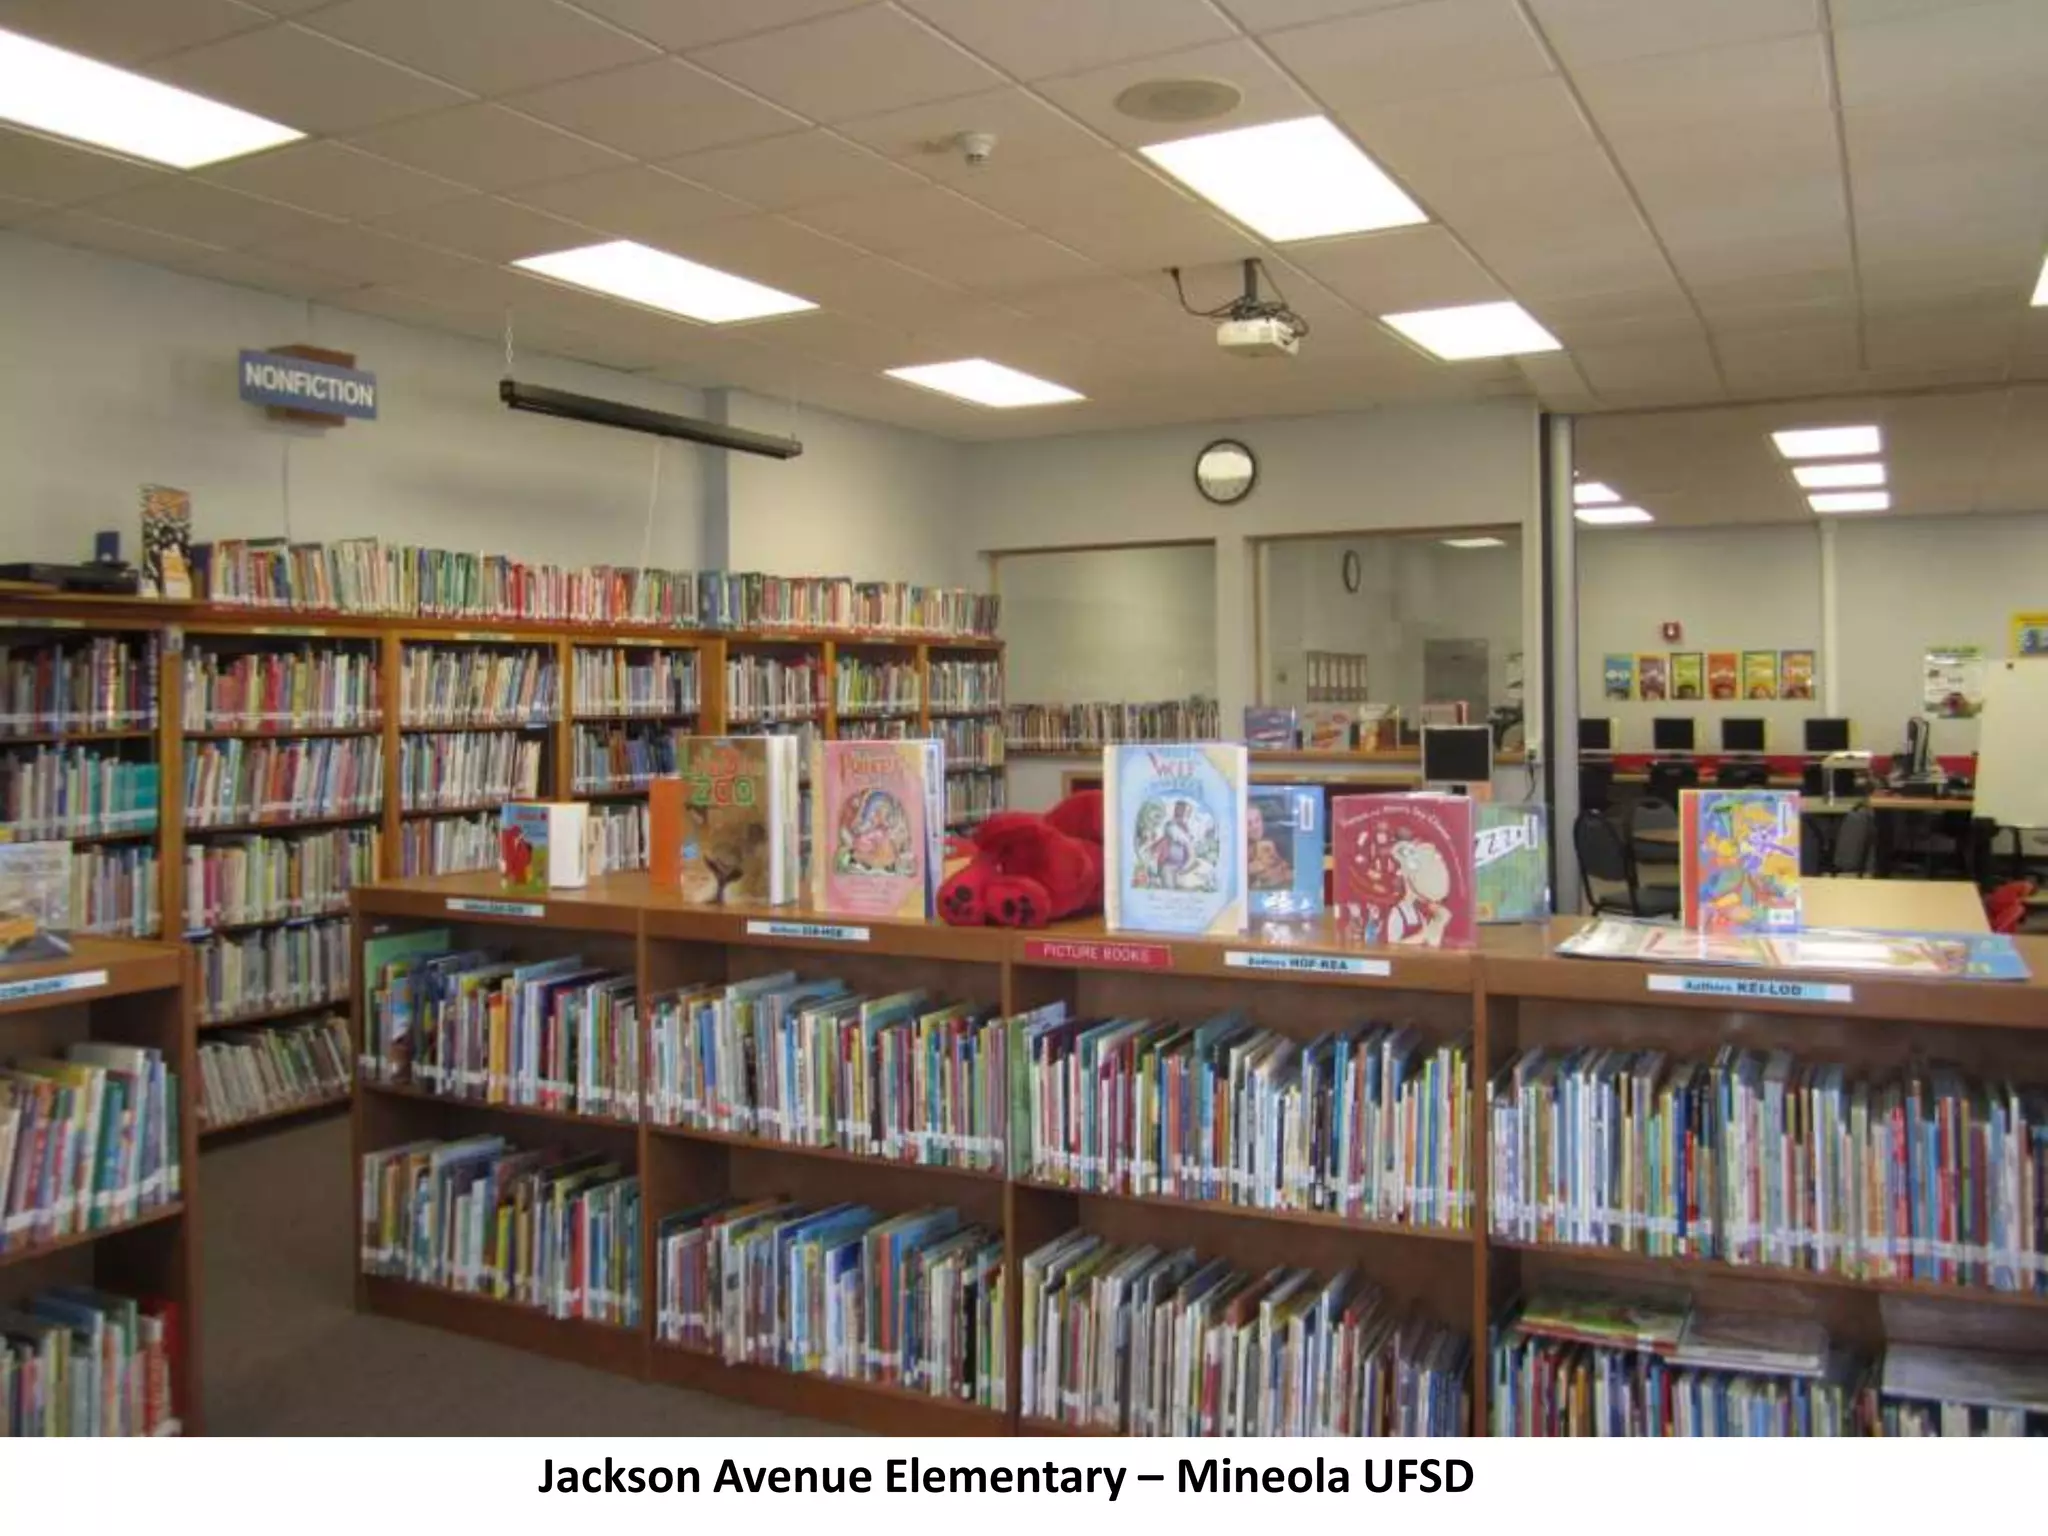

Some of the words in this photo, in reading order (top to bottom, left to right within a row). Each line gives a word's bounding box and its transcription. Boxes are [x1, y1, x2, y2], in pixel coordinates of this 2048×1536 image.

[245, 361, 374, 407] NONFICTION
[1043, 943, 1099, 960] PICTURE
[1103, 947, 1150, 964] BOOKS
[1685, 979, 1734, 993] Authors
